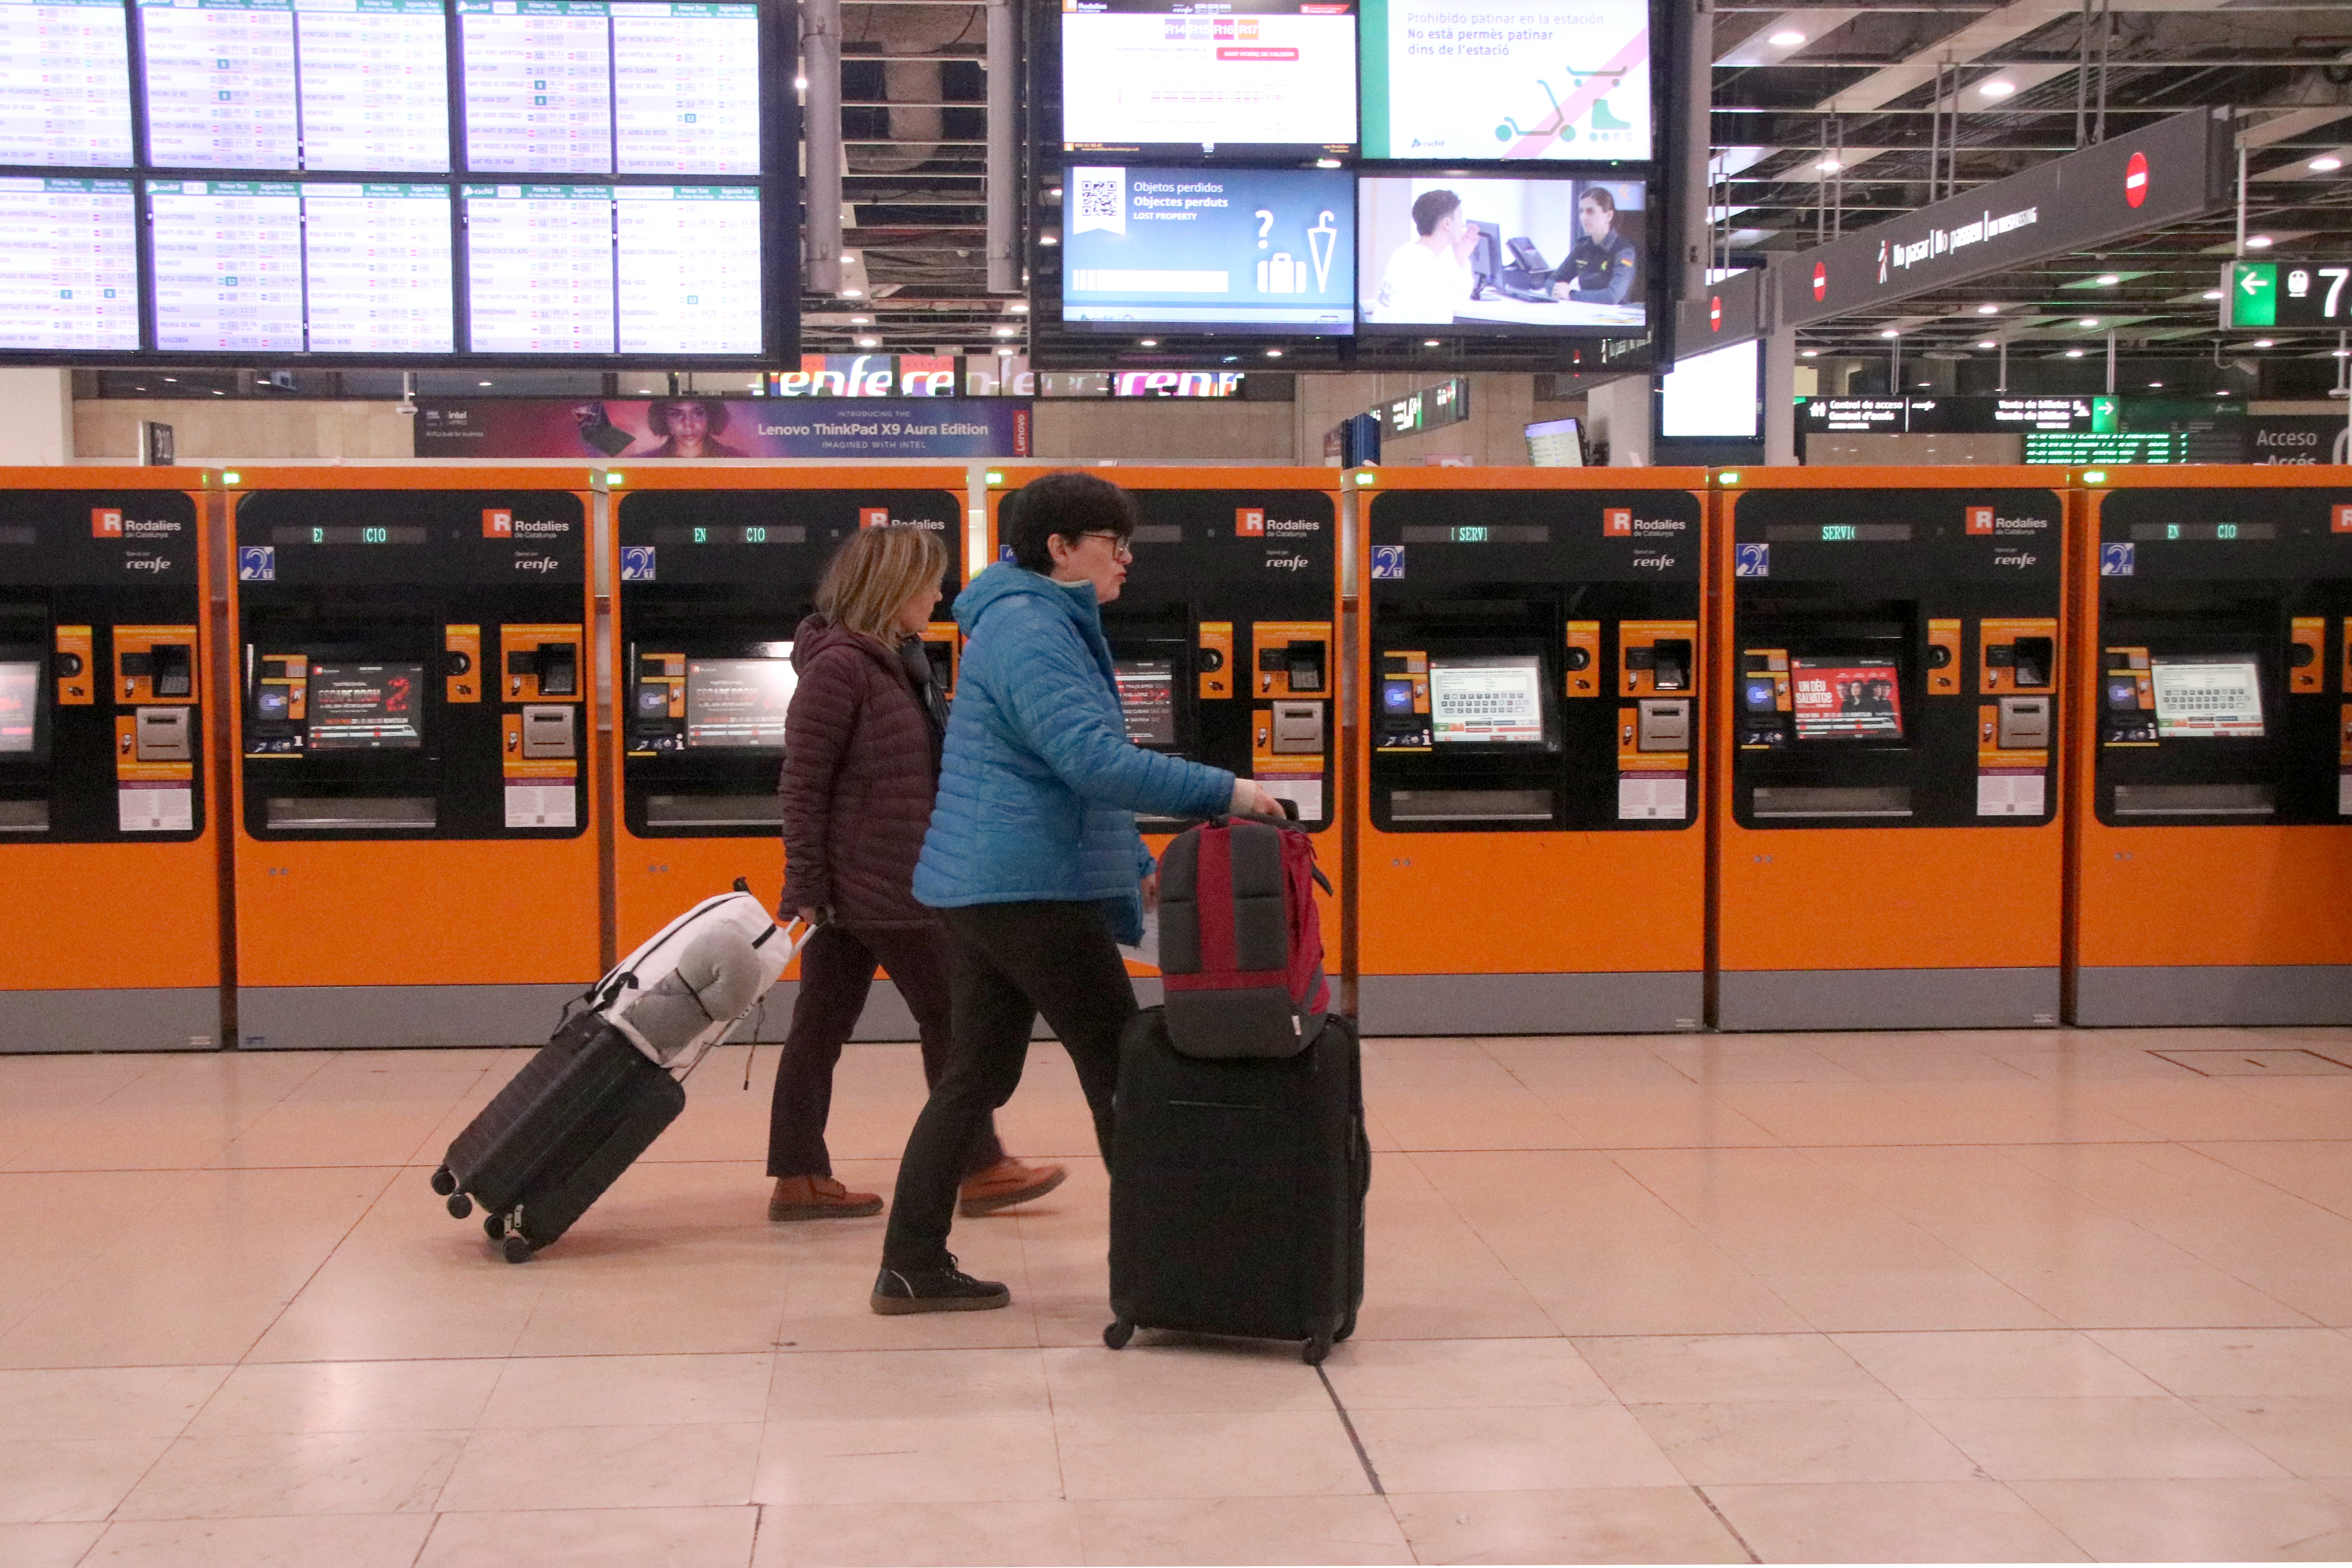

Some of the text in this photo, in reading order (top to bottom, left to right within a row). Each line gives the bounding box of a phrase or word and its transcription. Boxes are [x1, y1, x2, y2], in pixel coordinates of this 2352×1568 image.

[1408, 13, 1604, 26] Prohibido patinar en la estación
[1165, 24, 1186, 35] R14
[1189, 24, 1210, 35] R15
[1214, 24, 1234, 35] R16
[1239, 24, 1258, 35] R17
[1408, 28, 1553, 42] No està permès patinar
[1408, 45, 1509, 56] dins de l'estació
[1423, 139, 1446, 147] adif
[1134, 181, 1223, 194] Objetos perdidos
[1134, 196, 1228, 209] Objectes perduts
[1134, 212, 1197, 220] LOST PROPERTY
[1893, 244, 1905, 267] No
[1905, 239, 1929, 269] pasar
[1935, 229, 1948, 254] No
[2318, 269, 2349, 317] 7
[1830, 400, 1903, 409] Control de acceso
[1998, 400, 2070, 409] Venta de billetes
[448, 411, 467, 419] intel
[1829, 410, 1895, 420] Control d'accés
[2024, 411, 2037, 420] de
[758, 424, 989, 436] Lenovo ThinkPad X9 Aura Edition
[1016, 414, 1026, 452] Lenovo
[2256, 429, 2317, 447] Acceso
[104, 514, 181, 532] R Rodalies
[494, 514, 569, 532] R Rodalies
[1246, 513, 1320, 531] R Rodalies
[1614, 513, 1686, 530] R Rodalies
[1976, 511, 2048, 528] R Rodalies
[694, 528, 707, 542] EN
[746, 527, 766, 542] CIO
[2167, 525, 2179, 539] EN
[2217, 524, 2236, 539] CIO
[126, 557, 171, 573] renfe
[515, 557, 559, 573] renfe
[1266, 555, 1308, 572] renfe
[1633, 555, 1675, 571] renfe
[1994, 552, 2037, 569] renfe
[1798, 678, 1826, 692] UN DÉU
